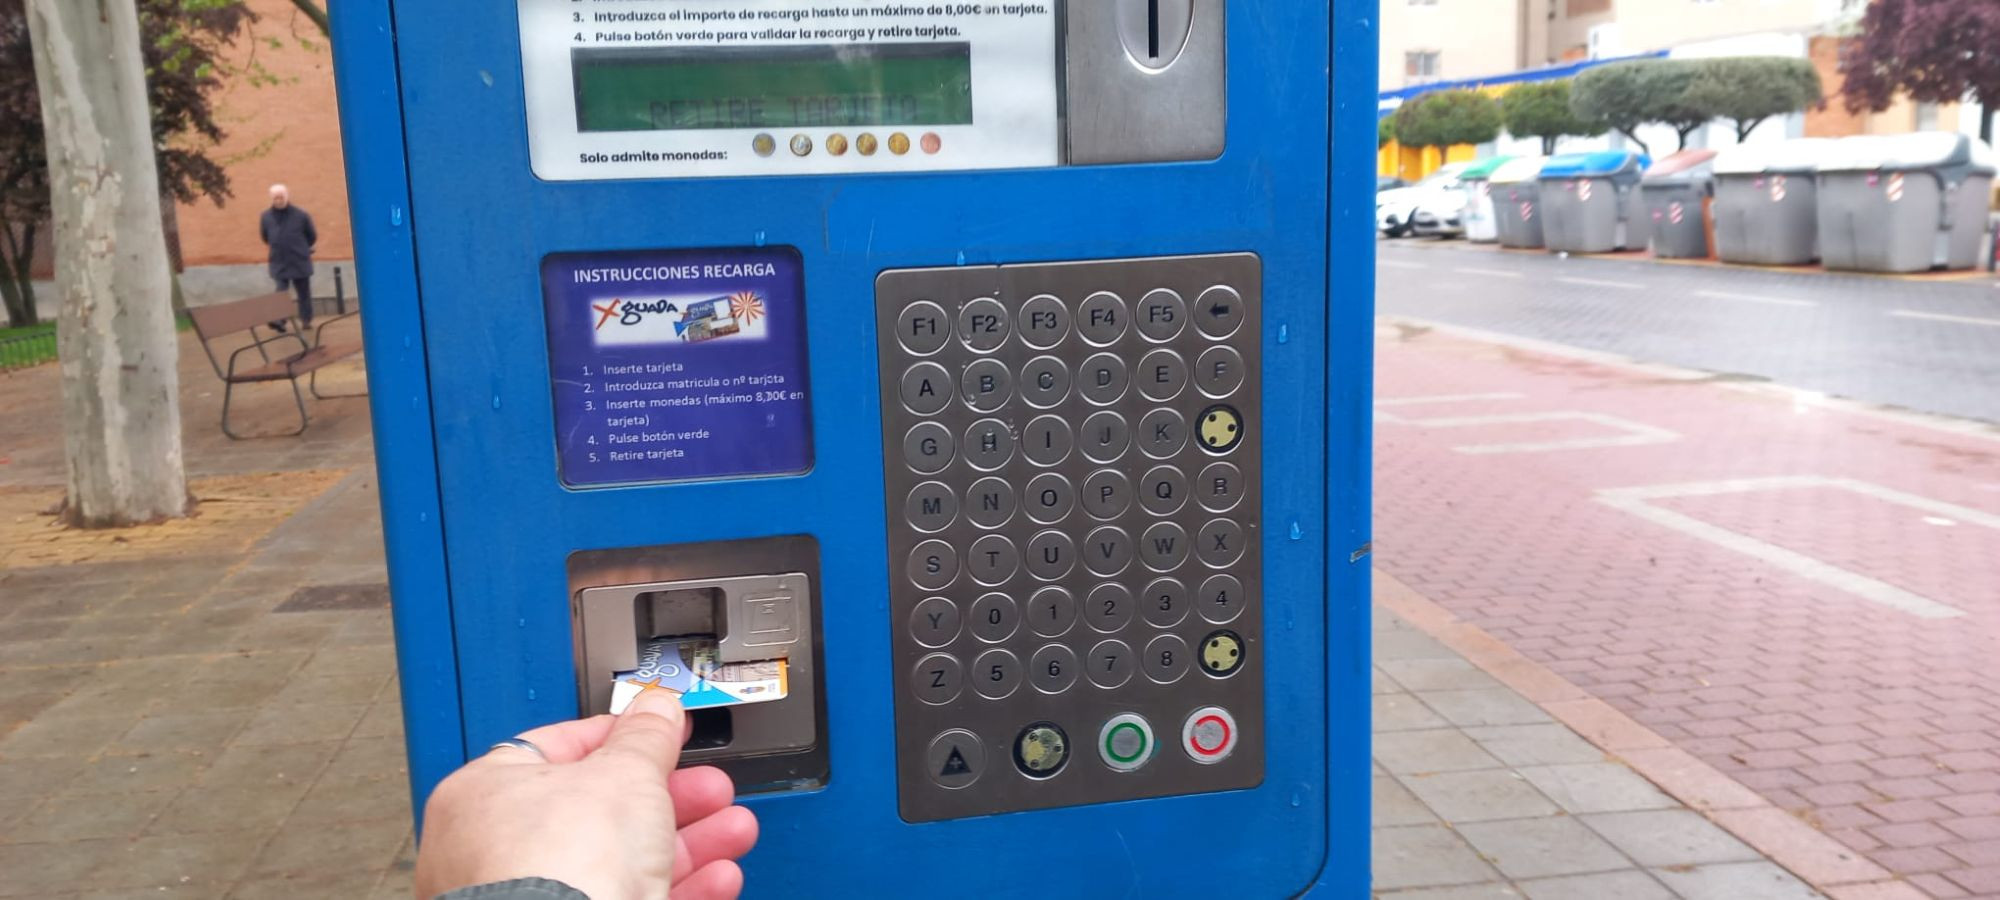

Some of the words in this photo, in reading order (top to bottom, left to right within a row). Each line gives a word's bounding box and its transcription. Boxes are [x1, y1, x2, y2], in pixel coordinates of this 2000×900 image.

[573, 12, 584, 22] 3.
[594, 11, 666, 22] Introduzca
[669, 10, 681, 20] el
[683, 9, 736, 23] importe
[739, 10, 755, 20] de
[758, 8, 809, 21] recarga
[812, 7, 849, 18] hasta
[852, 8, 868, 16] un
[871, 5, 924, 17] máximo
[927, 6, 944, 15] de
[946, 5, 982, 16] 8,00€
[1002, 4, 1048, 17] tarjeta.
[574, 32, 586, 42] 4.
[596, 32, 631, 42] Pulse
[635, 30, 672, 41] botón
[676, 30, 713, 40] verde
[717, 30, 748, 42] para
[751, 28, 797, 39] validar
[800, 28, 811, 38] la
[814, 28, 865, 40] recarga
[868, 28, 875, 40] y
[878, 26, 912, 37] retire
[915, 25, 961, 38] tarjeta.
[580, 152, 608, 163] Solo
[611, 150, 659, 162] admite
[662, 150, 727, 161] monedas:
[574, 265, 699, 283] INSTRUCCIONES
[703, 262, 776, 278] RECARGA
[912, 318, 936, 336] F1
[971, 315, 997, 333] F2
[1031, 312, 1057, 329] F3
[1090, 309, 1115, 327] F4
[1149, 306, 1174, 323] F5
[583, 366, 593, 376] 1.
[604, 364, 642, 375] Inserte
[646, 363, 683, 375] tarjeta
[919, 380, 934, 397] A
[980, 376, 995, 392] B
[1038, 372, 1053, 391] C
[1096, 369, 1111, 388] D
[1156, 366, 1169, 382] E
[1213, 362, 1226, 379] F
[584, 383, 594, 393] 2.
[605, 380, 665, 392] Introduzca
[585, 401, 596, 411] 3.
[606, 398, 646, 410] Inserte
[650, 396, 701, 407] monedas
[704, 394, 752, 406] (máximo
[790, 391, 804, 400] en
[607, 414, 650, 427] tarjeta)
[588, 435, 599, 445] 4.
[609, 433, 639, 443] Pulse
[642, 430, 674, 442] botón
[678, 429, 710, 440] verde
[921, 438, 937, 456] G
[982, 435, 997, 454] H
[1046, 432, 1051, 449] I
[1099, 427, 1111, 446] J
[1156, 424, 1171, 441] K
[589, 452, 600, 462] 5.
[610, 450, 644, 461] Retire
[647, 449, 684, 460] tarjeta
[922, 498, 941, 515] M
[983, 493, 999, 511] N
[1101, 486, 1113, 502] P
[1156, 482, 1172, 499] Q
[1213, 478, 1227, 495] R
[926, 556, 941, 573] S
[985, 551, 999, 568] T
[1044, 548, 1058, 564] U
[1100, 542, 1115, 558] V
[1154, 538, 1174, 554] W
[1213, 534, 1227, 551] X
[927, 612, 942, 629] Y
[1049, 604, 1057, 619] 1
[1104, 600, 1115, 616] 2
[1159, 595, 1171, 611] 3
[1216, 590, 1227, 606] 4
[931, 671, 945, 688] Z
[991, 666, 1002, 682] 5
[1048, 661, 1060, 676] 6
[1104, 656, 1116, 671] 7
[1161, 651, 1172, 666] 8
